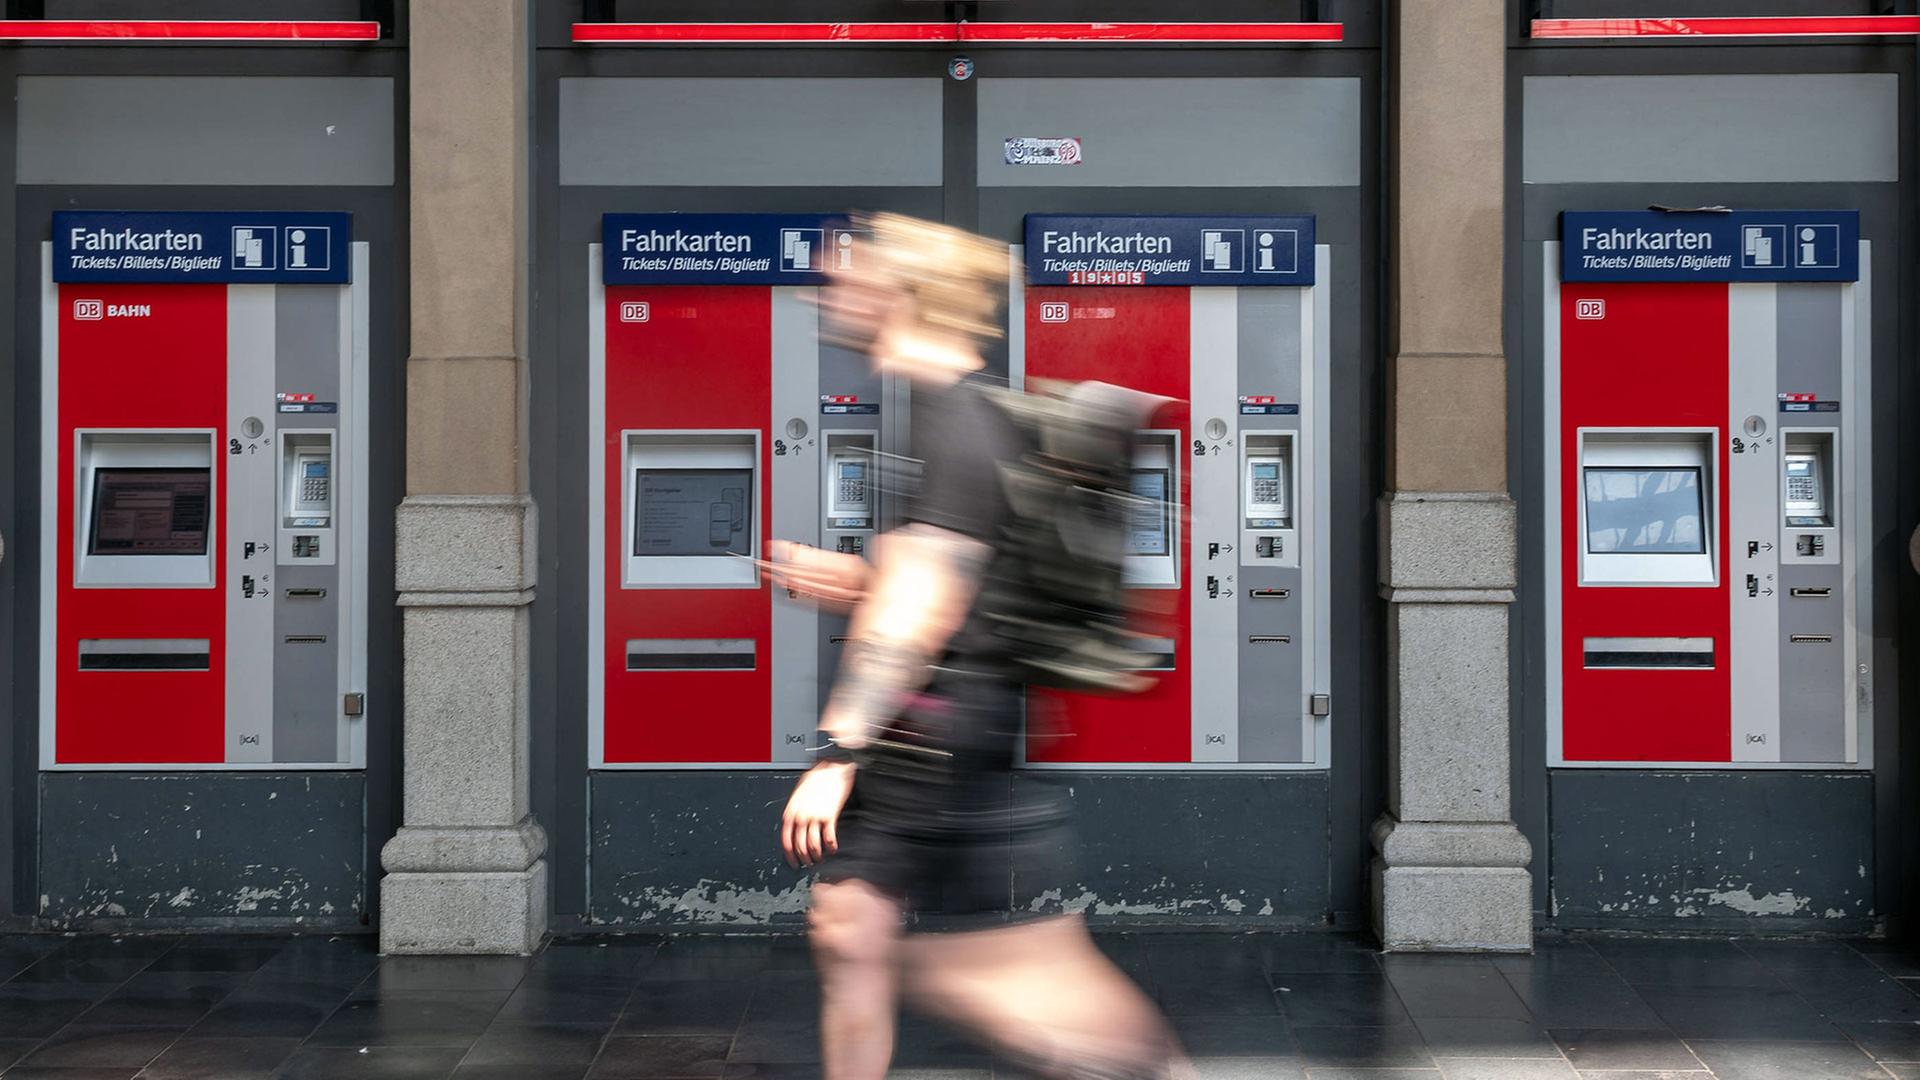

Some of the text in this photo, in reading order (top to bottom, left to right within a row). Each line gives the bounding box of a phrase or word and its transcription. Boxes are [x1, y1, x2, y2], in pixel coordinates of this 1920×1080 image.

[71, 228, 202, 251] Fahrkarten
[622, 229, 751, 252] Fahrkarten
[1043, 231, 1172, 254] Fahrkarten
[1583, 228, 1712, 250] Fahrkarten
[71, 255, 222, 271] Tickets/Billets/Biglietti
[622, 257, 770, 273] Tickets/Billets/Biglietti
[1043, 258, 1191, 275] Tickets/Billets/Biglietti
[1582, 255, 1732, 270] Tickets/Billets/Biglietti
[107, 304, 151, 318] BAHN
